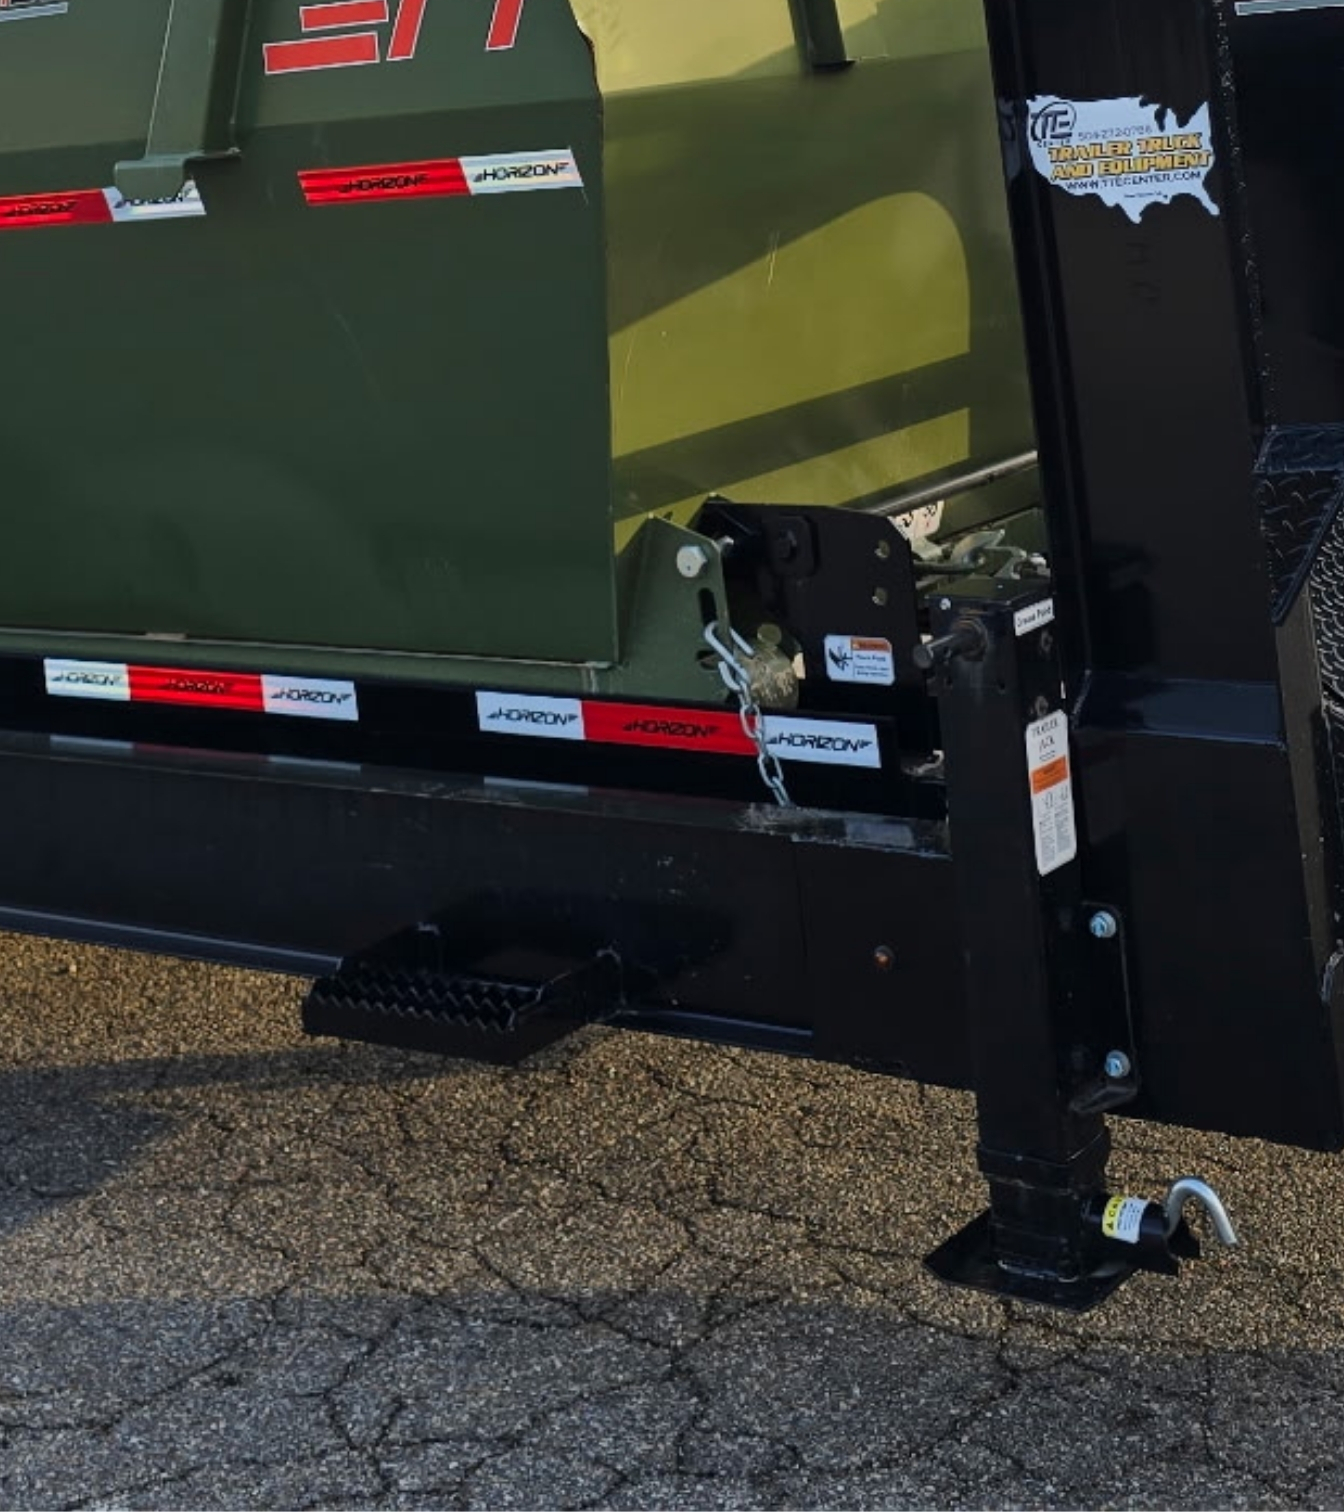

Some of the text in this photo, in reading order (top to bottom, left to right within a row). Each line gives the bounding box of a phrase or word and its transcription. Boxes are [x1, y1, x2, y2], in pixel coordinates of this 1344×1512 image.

[1048, 132, 1202, 162] TRAILER TRUCK
[473, 162, 569, 182] HORIZON
[1051, 150, 1211, 181] AND EQUIPMENT
[340, 174, 428, 193] HORIZON
[1066, 170, 1201, 190] WWW.TTECENTER.COM
[272, 688, 351, 704] HORIZON
[487, 706, 577, 725] HORIZON
[622, 719, 717, 738] HORIZON
[768, 731, 872, 752] HORIZON
